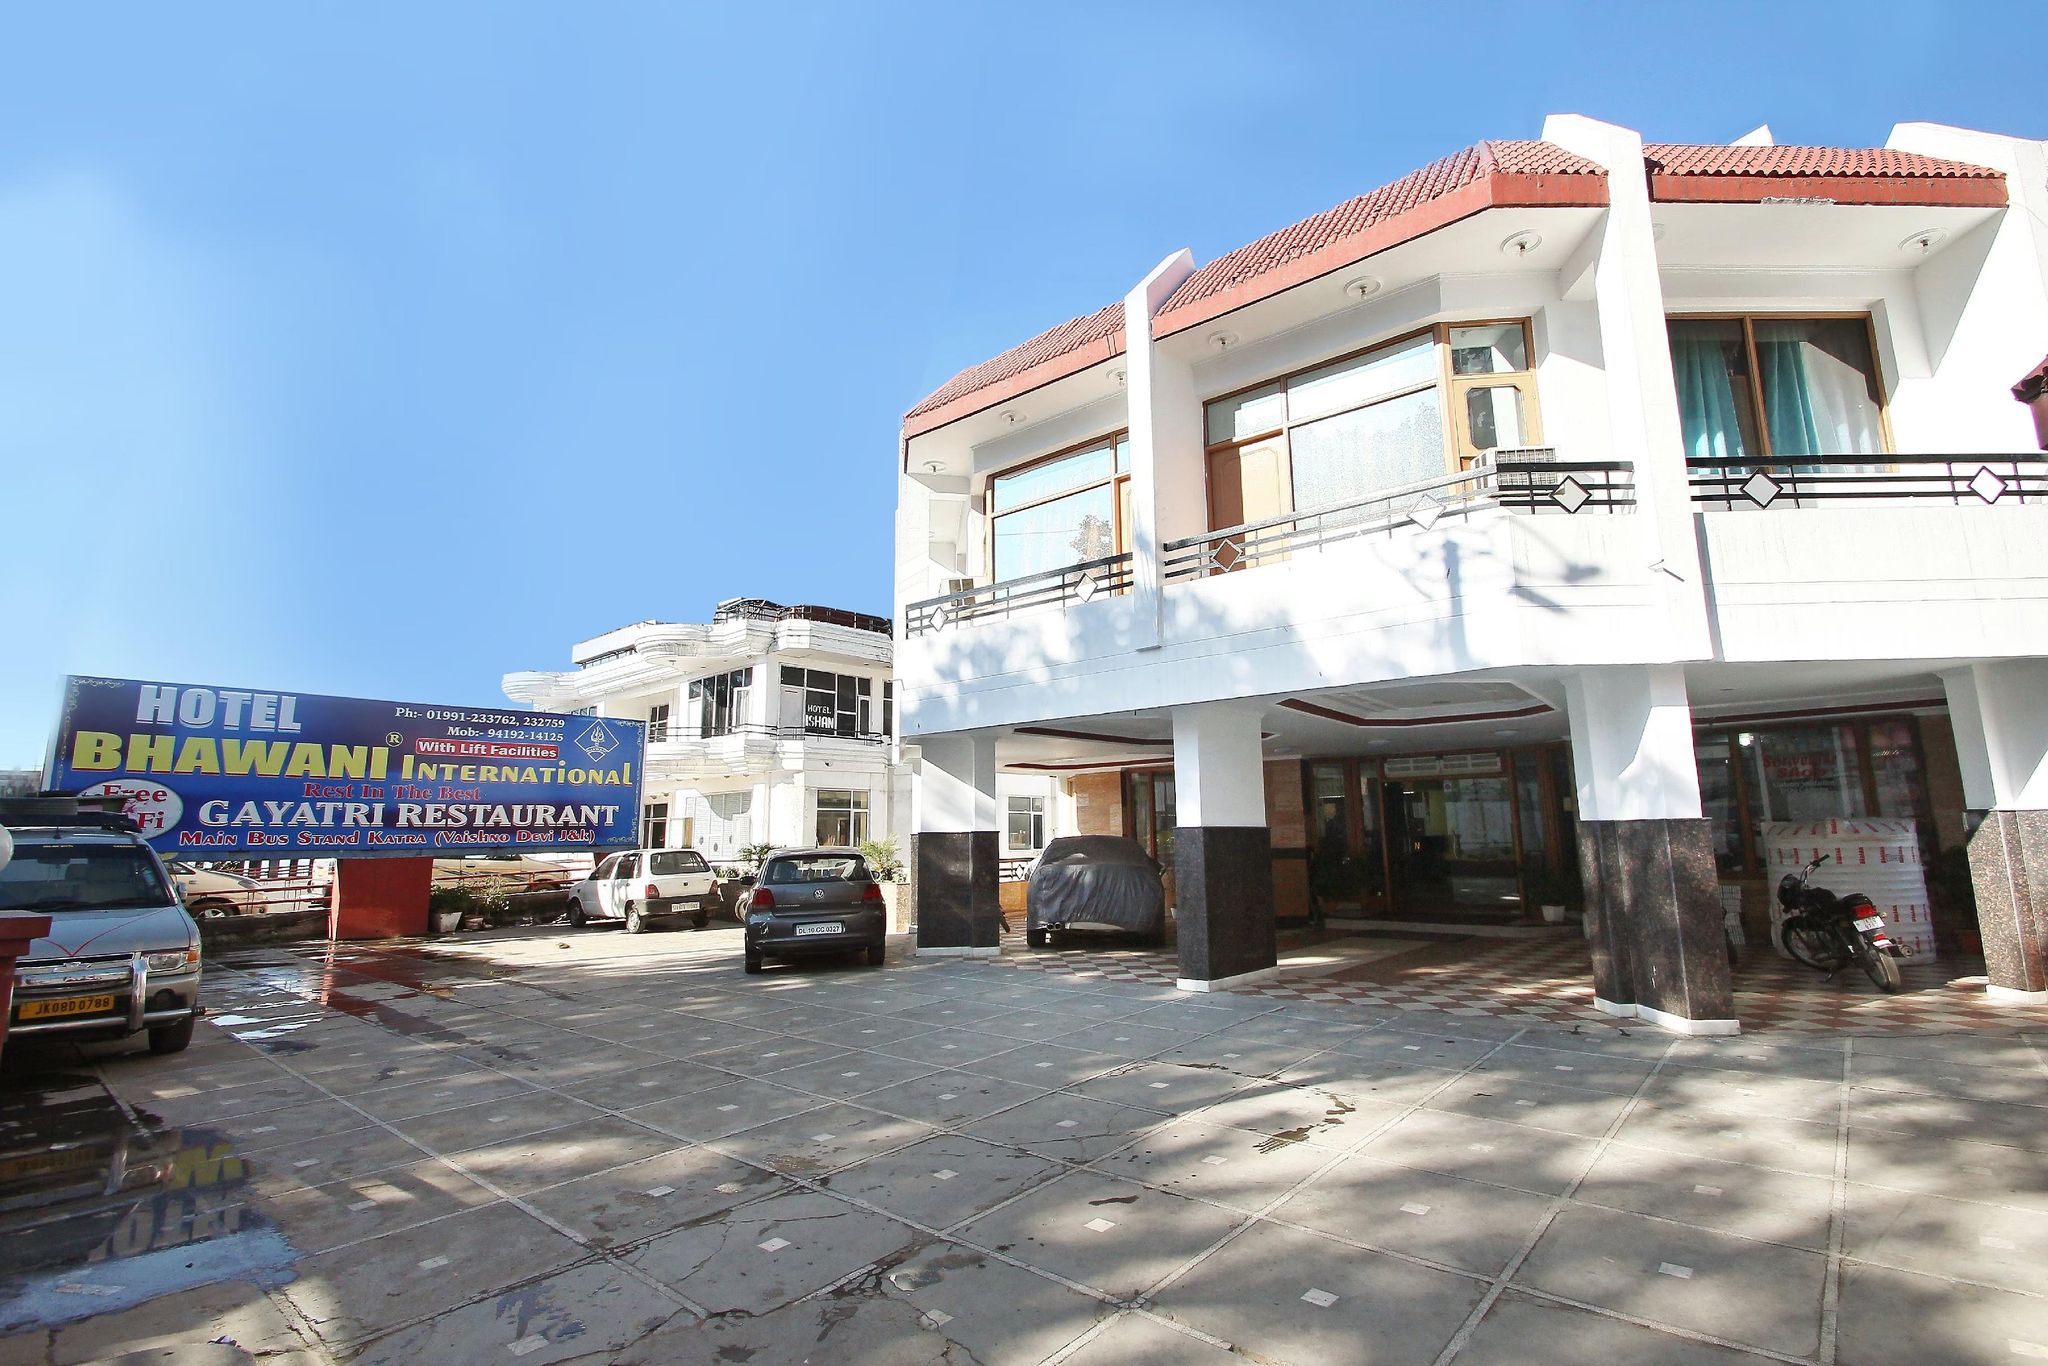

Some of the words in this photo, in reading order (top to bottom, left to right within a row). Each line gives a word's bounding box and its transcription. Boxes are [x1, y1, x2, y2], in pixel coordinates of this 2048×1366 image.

[136, 684, 302, 734] HOTEL
[426, 709, 520, 726] 01991-233762,
[523, 716, 566, 728] 232759
[805, 714, 834, 729] ISHAN
[487, 728, 564, 743] 94192-14125
[72, 731, 389, 781] BHAWANI
[418, 741, 458, 753] With
[461, 743, 489, 755] Lift
[491, 745, 557, 758] Facilities
[302, 782, 354, 799] Rest
[361, 784, 385, 799] In
[391, 783, 433, 800] The
[438, 785, 481, 801] Best
[199, 800, 385, 828] GAYATRI
[395, 803, 619, 828] RESTAURANT
